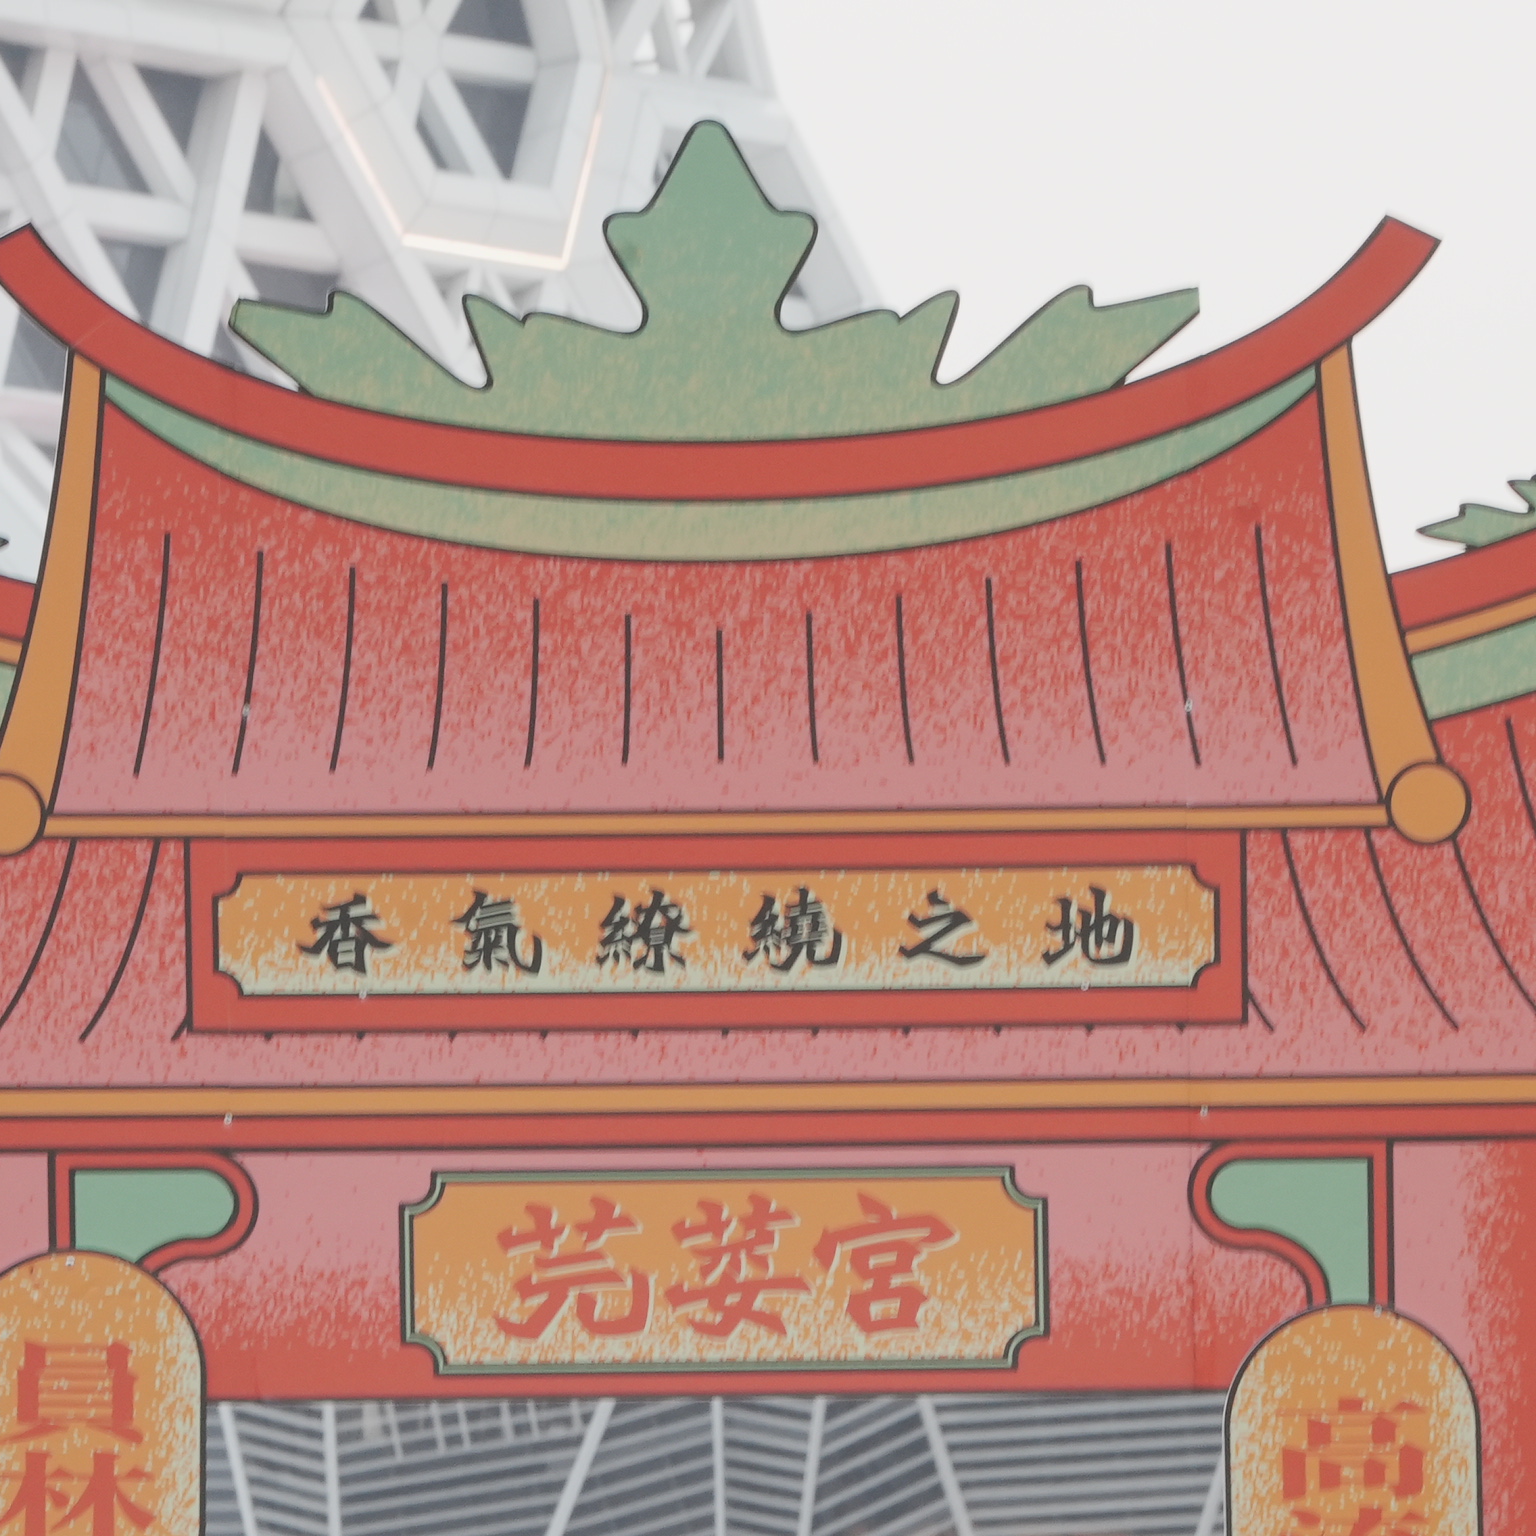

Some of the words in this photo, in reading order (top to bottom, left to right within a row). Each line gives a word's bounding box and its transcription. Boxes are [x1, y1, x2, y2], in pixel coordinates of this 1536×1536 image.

[298, 886, 1135, 976] 香氣繚繞之地
[493, 1191, 959, 1339] 芫荽宮
